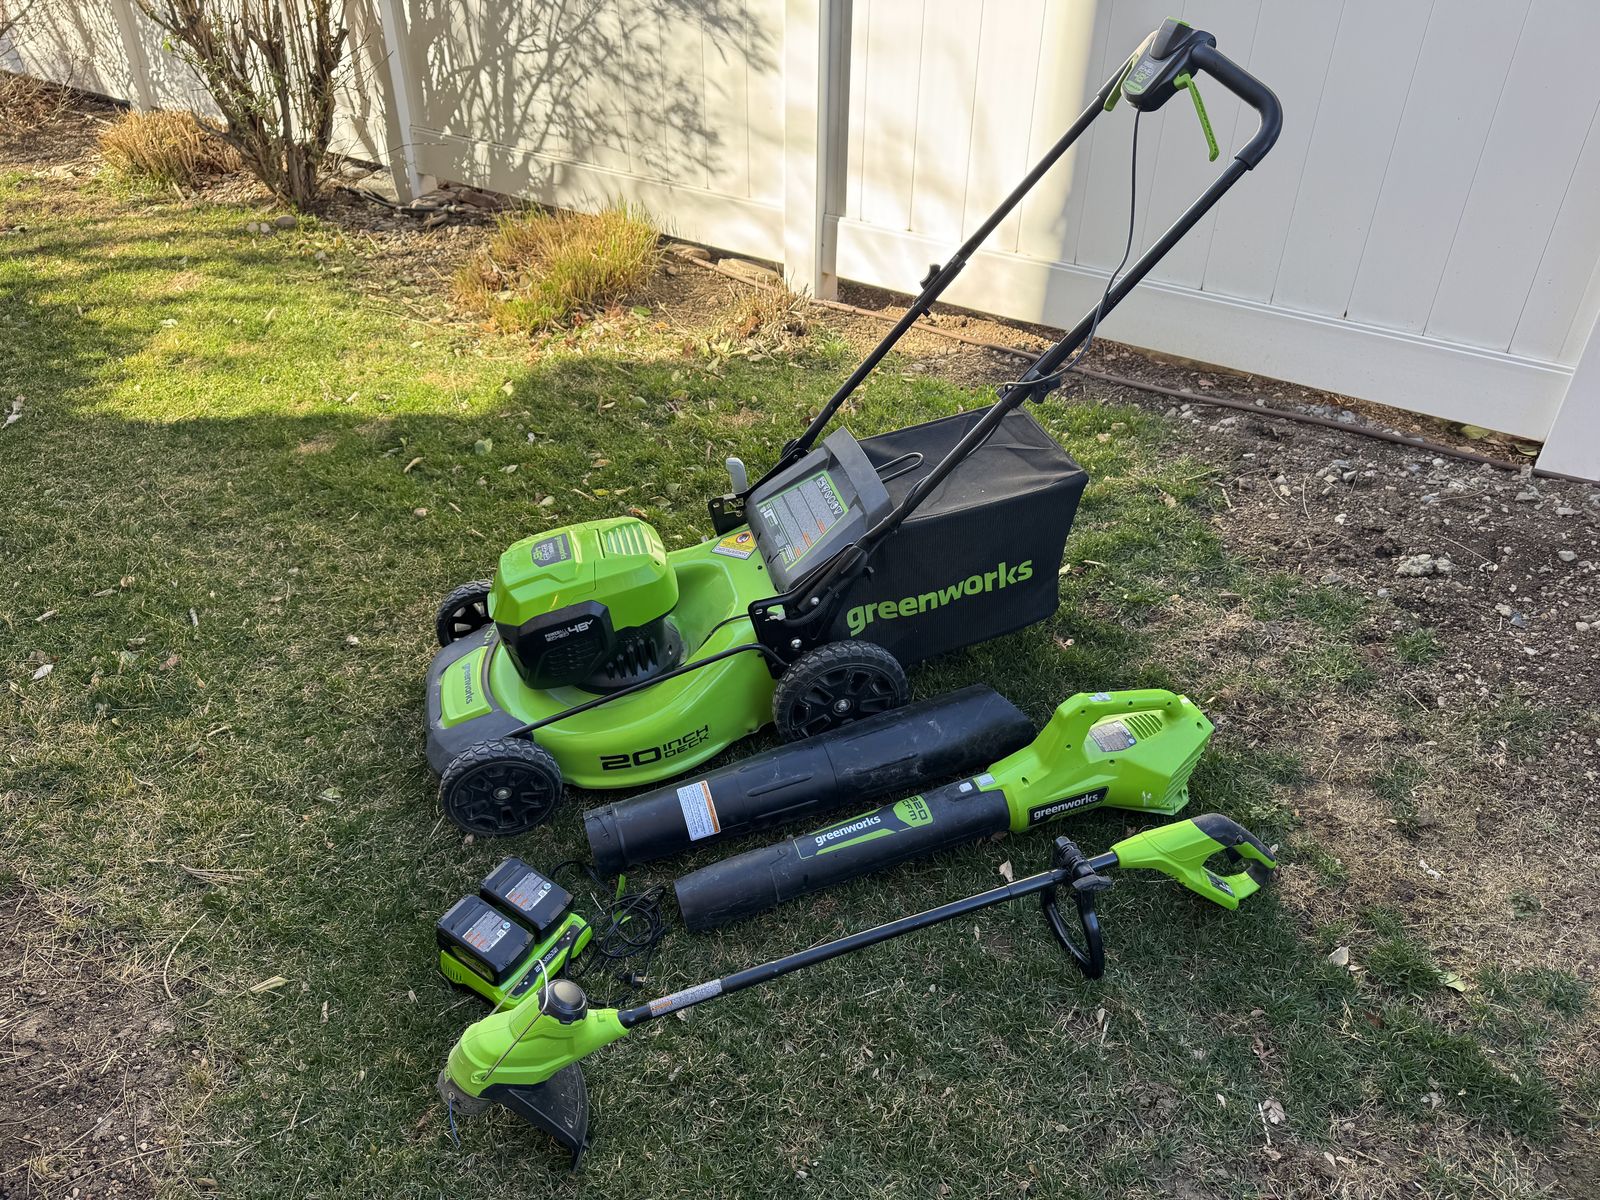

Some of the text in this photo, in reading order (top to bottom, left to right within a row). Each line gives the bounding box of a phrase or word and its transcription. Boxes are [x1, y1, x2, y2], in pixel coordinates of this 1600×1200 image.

[846, 559, 1034, 637] greenworks
[567, 619, 594, 633] 48V
[599, 724, 709, 771] 20 INCH
[664, 733, 710, 758] DECK
[909, 796, 928, 820] 320
[1033, 793, 1099, 821] greenworks
[815, 815, 882, 847] greenworks
